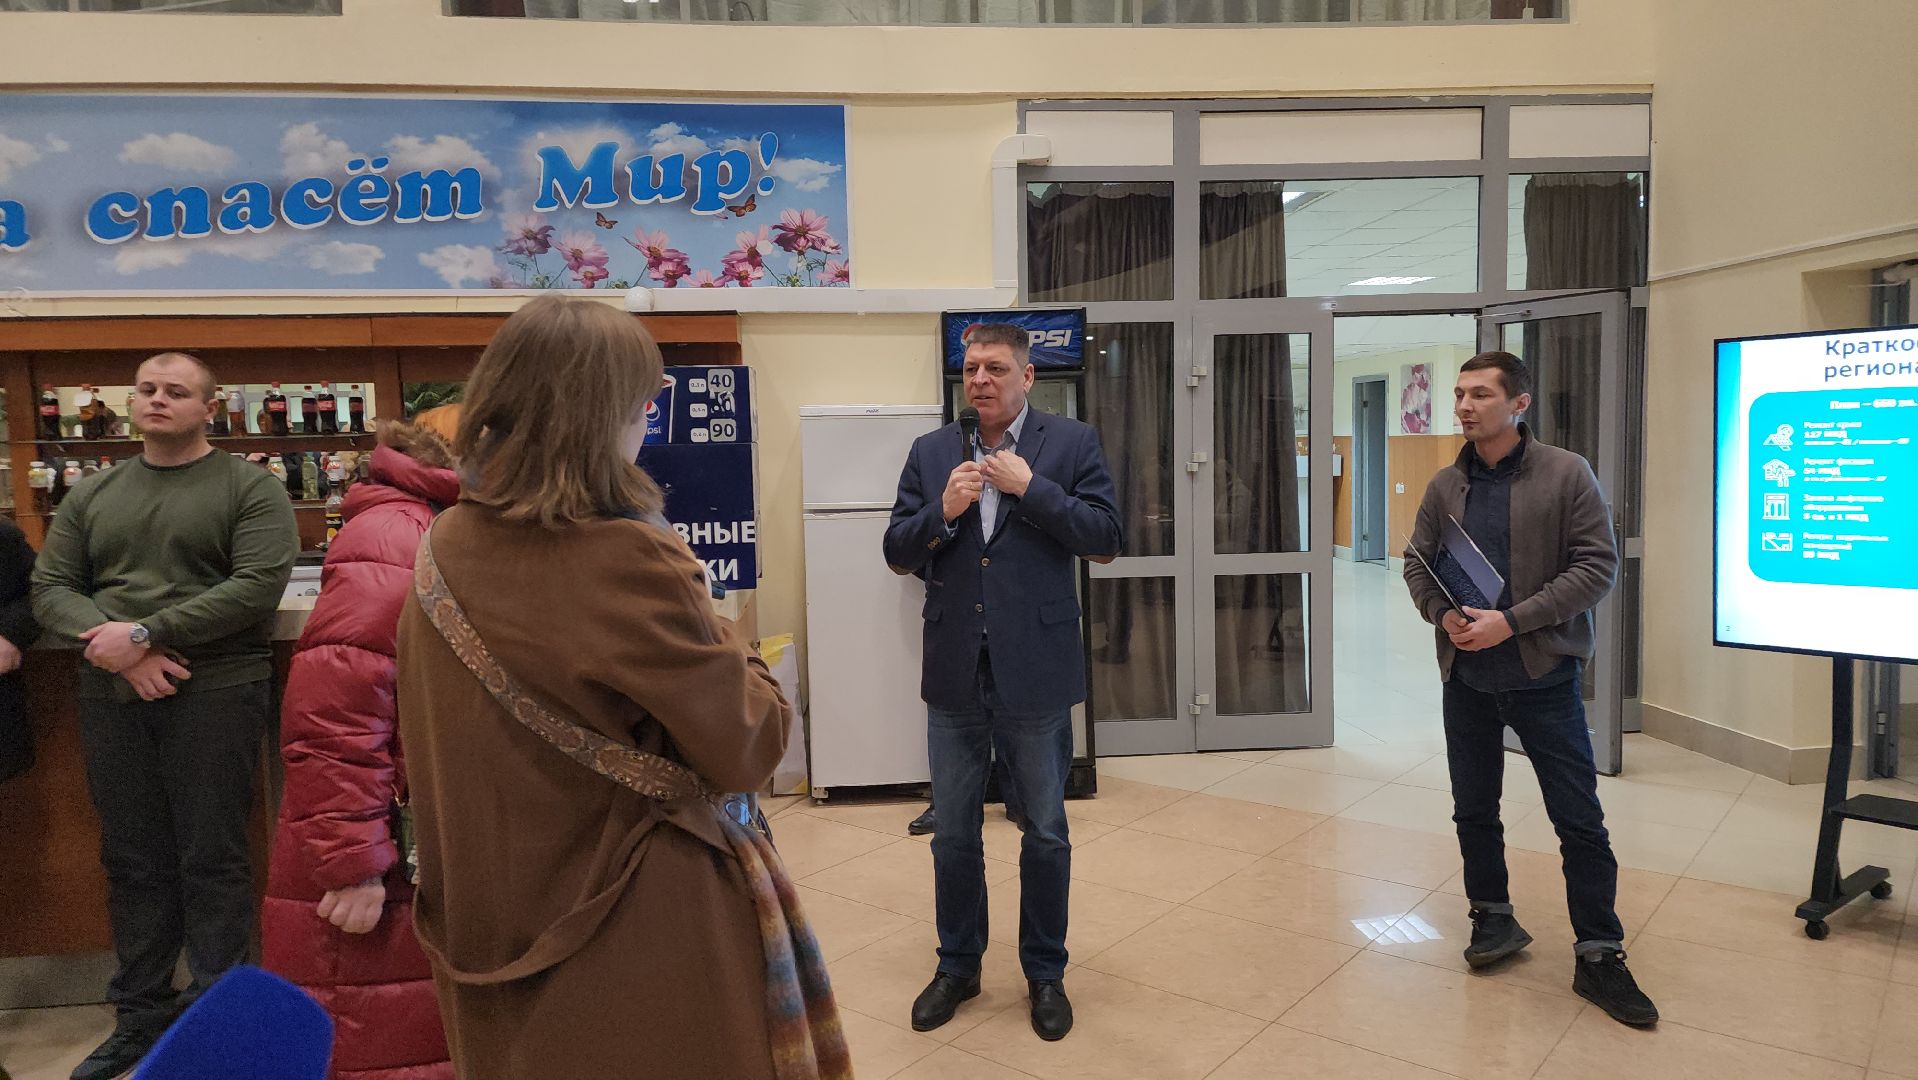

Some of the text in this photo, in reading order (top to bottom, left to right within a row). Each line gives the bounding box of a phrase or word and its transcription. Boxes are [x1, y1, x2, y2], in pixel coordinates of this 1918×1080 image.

[85, 156, 484, 246] спасём
[534, 131, 780, 216] Мир!
[1825, 338, 1918, 359] Кратко
[711, 374, 732, 388] 40
[712, 423, 734, 437] 90
[672, 520, 756, 545] ВНЫЕ
